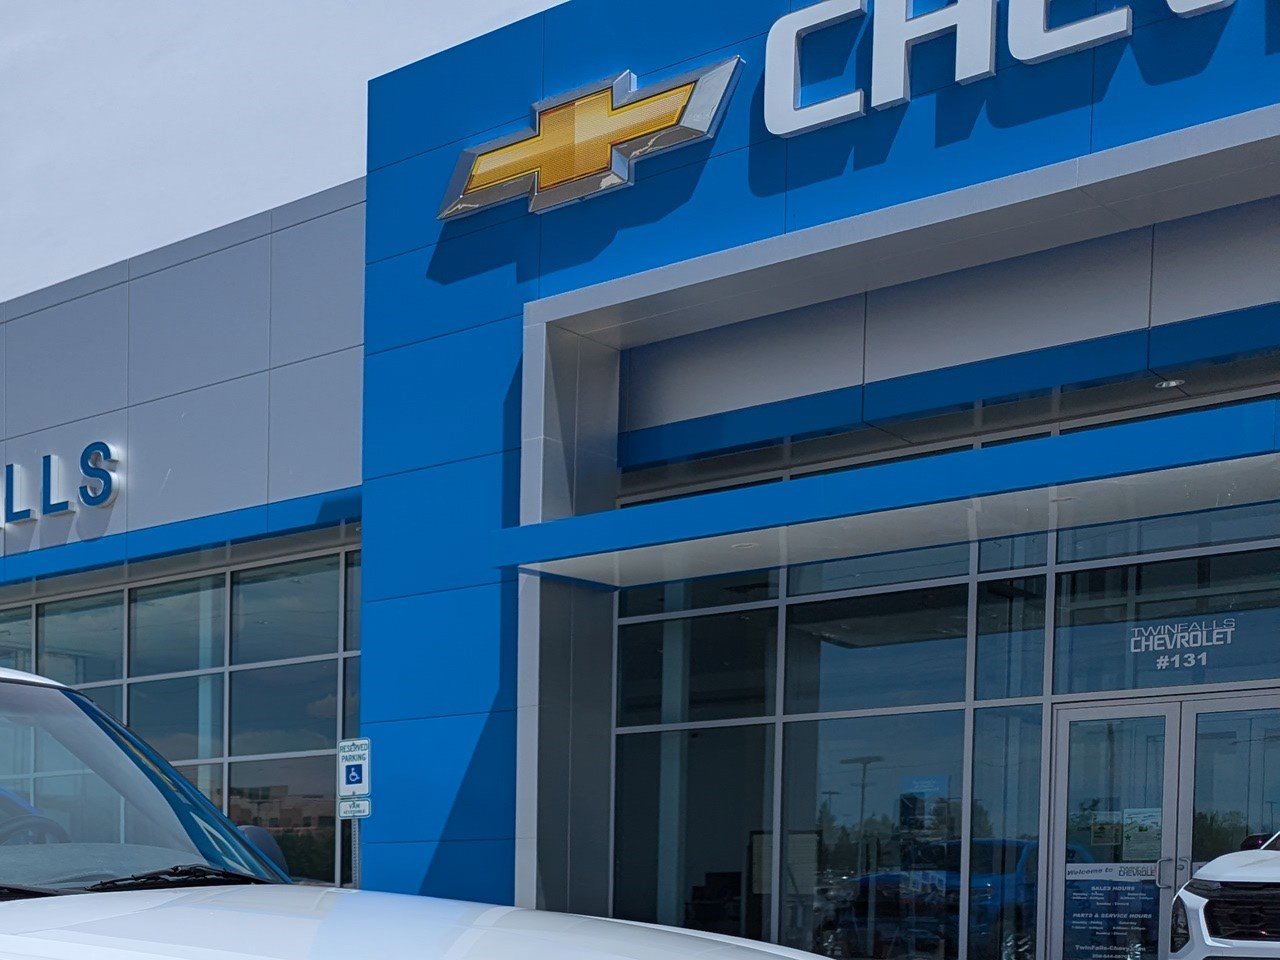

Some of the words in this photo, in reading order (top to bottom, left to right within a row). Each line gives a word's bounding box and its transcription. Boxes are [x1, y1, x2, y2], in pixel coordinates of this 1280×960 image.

[764, 0, 1237, 138] CHE
[1130, 628, 1235, 653] CHEVROLET
[1156, 652, 1207, 670] #131
[340, 744, 368, 753] RESERVED
[342, 754, 366, 762] PARKING
[1067, 868, 1103, 876] Welcome
[1118, 869, 1156, 877] CHEVROLE
